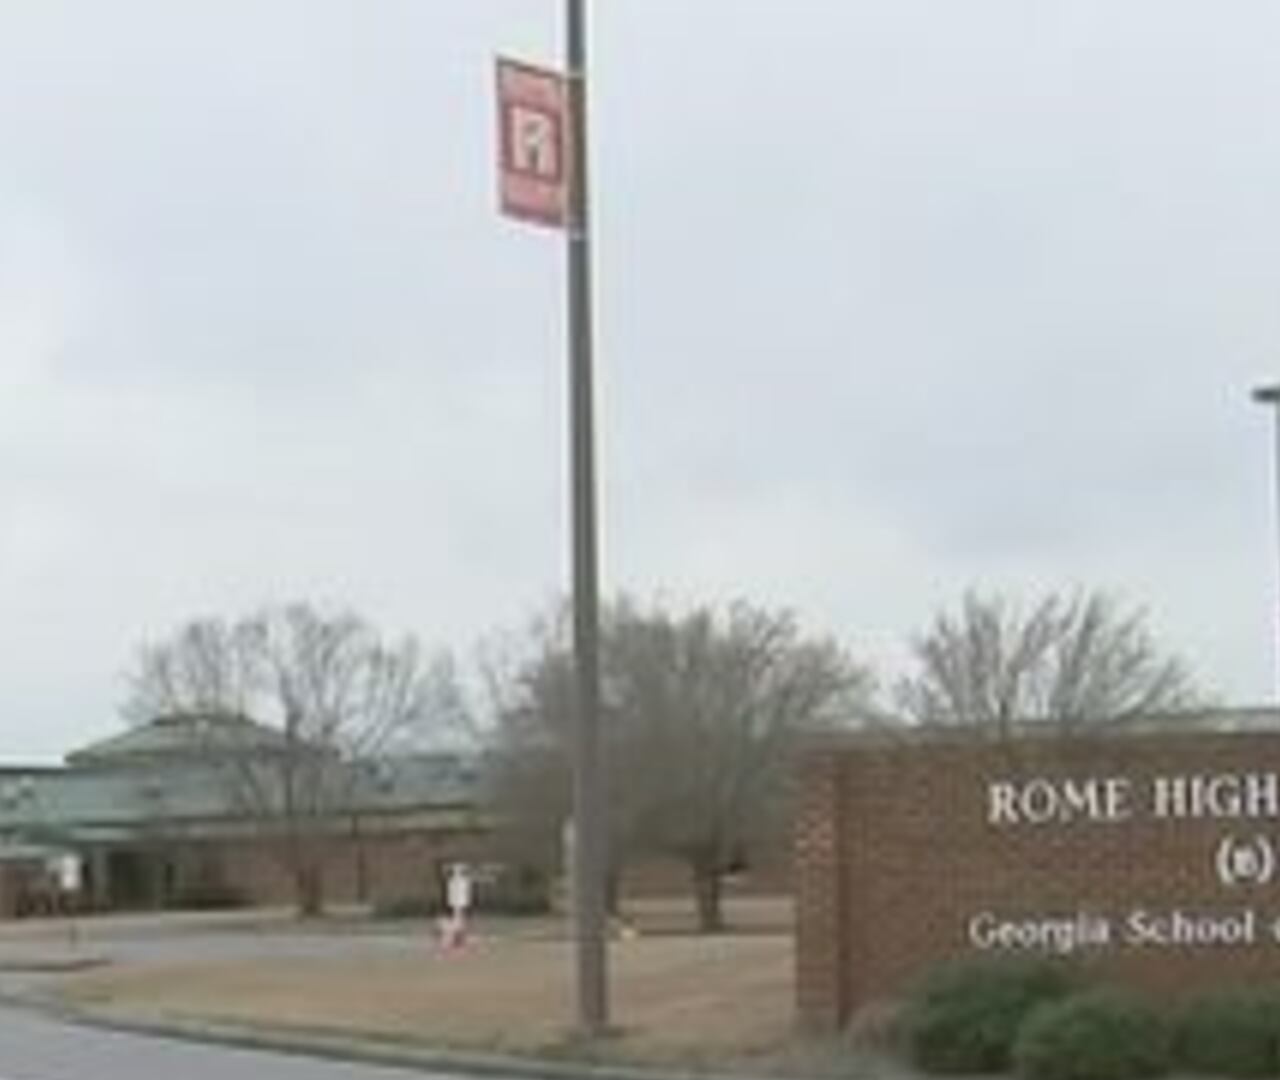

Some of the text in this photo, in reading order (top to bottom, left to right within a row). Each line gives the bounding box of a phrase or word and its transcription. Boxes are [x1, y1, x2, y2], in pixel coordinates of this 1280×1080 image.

[510, 103, 557, 176] R
[986, 779, 1132, 824] ROME
[1153, 773, 1280, 816] HIGH
[968, 911, 1110, 954] Georgia
[1127, 909, 1253, 946] School
